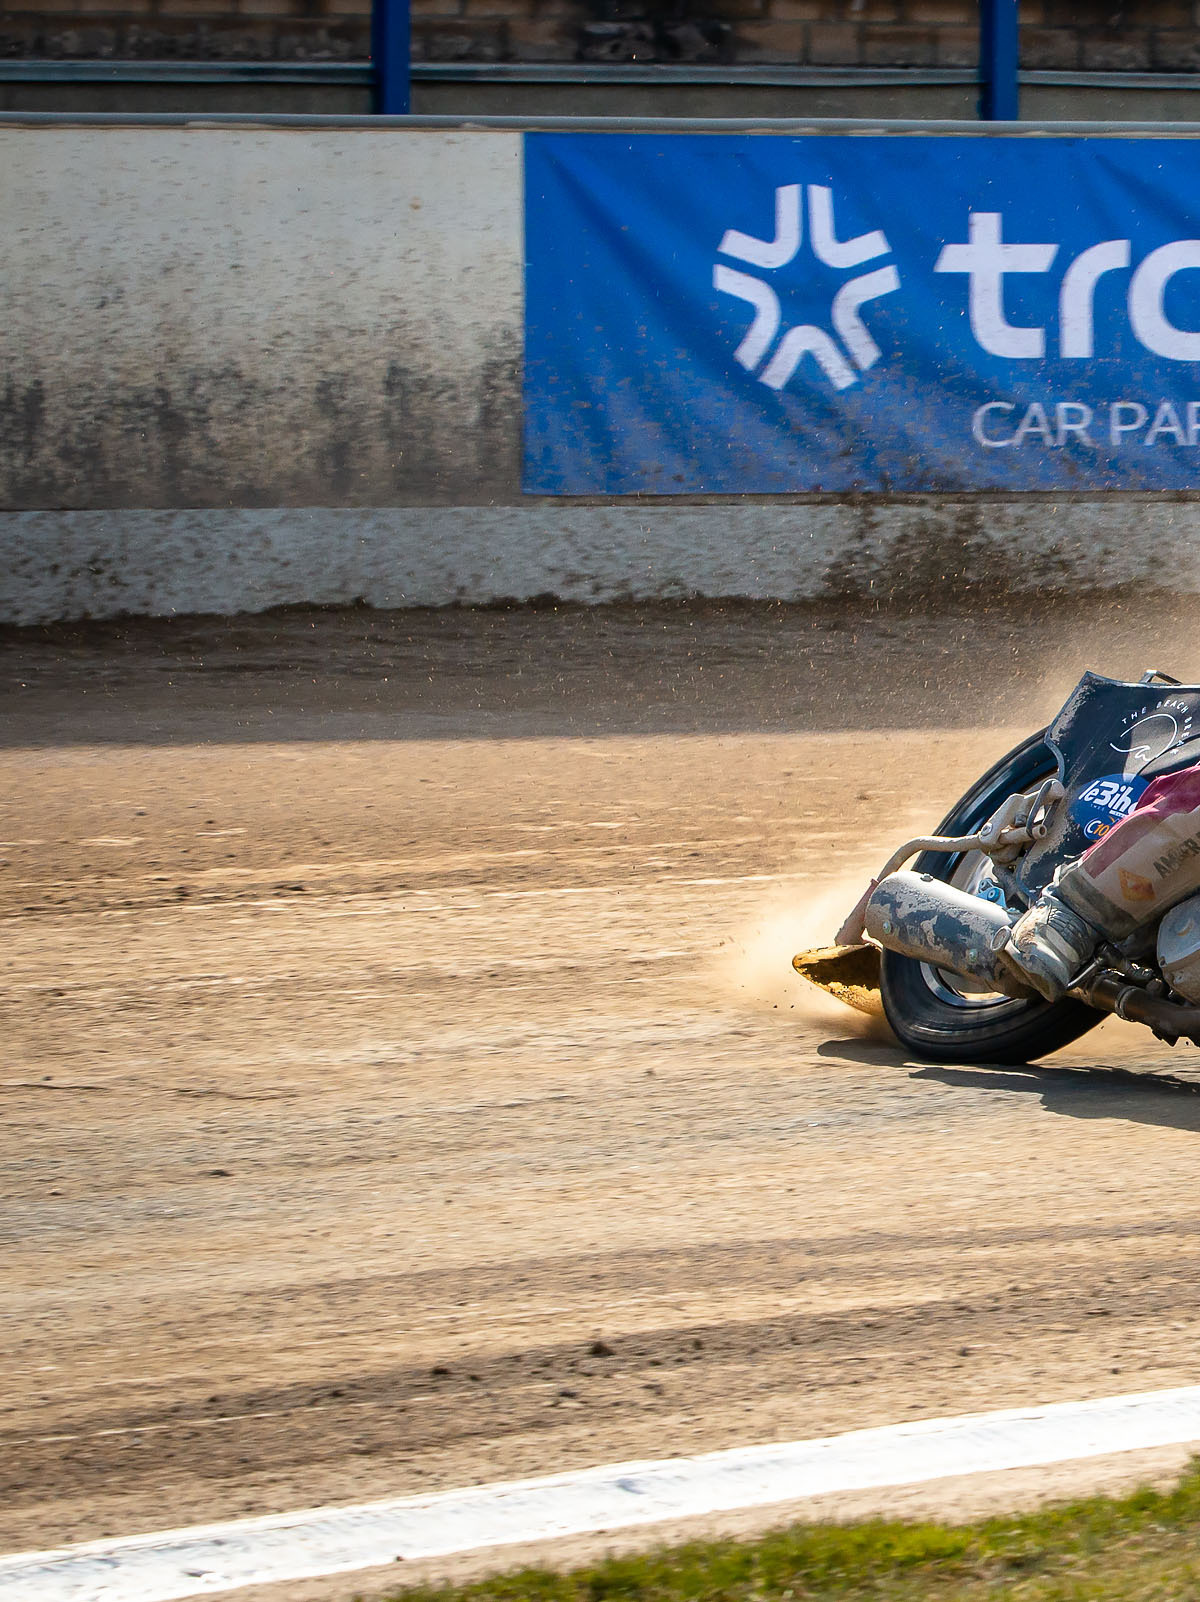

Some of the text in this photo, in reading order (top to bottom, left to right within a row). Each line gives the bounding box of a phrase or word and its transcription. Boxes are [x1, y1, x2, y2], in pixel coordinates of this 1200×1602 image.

[972, 401, 1094, 448] CAR
[1122, 707, 1147, 724] THE
[1156, 700, 1190, 714] BEACH
[1078, 780, 1138, 815] leBih
